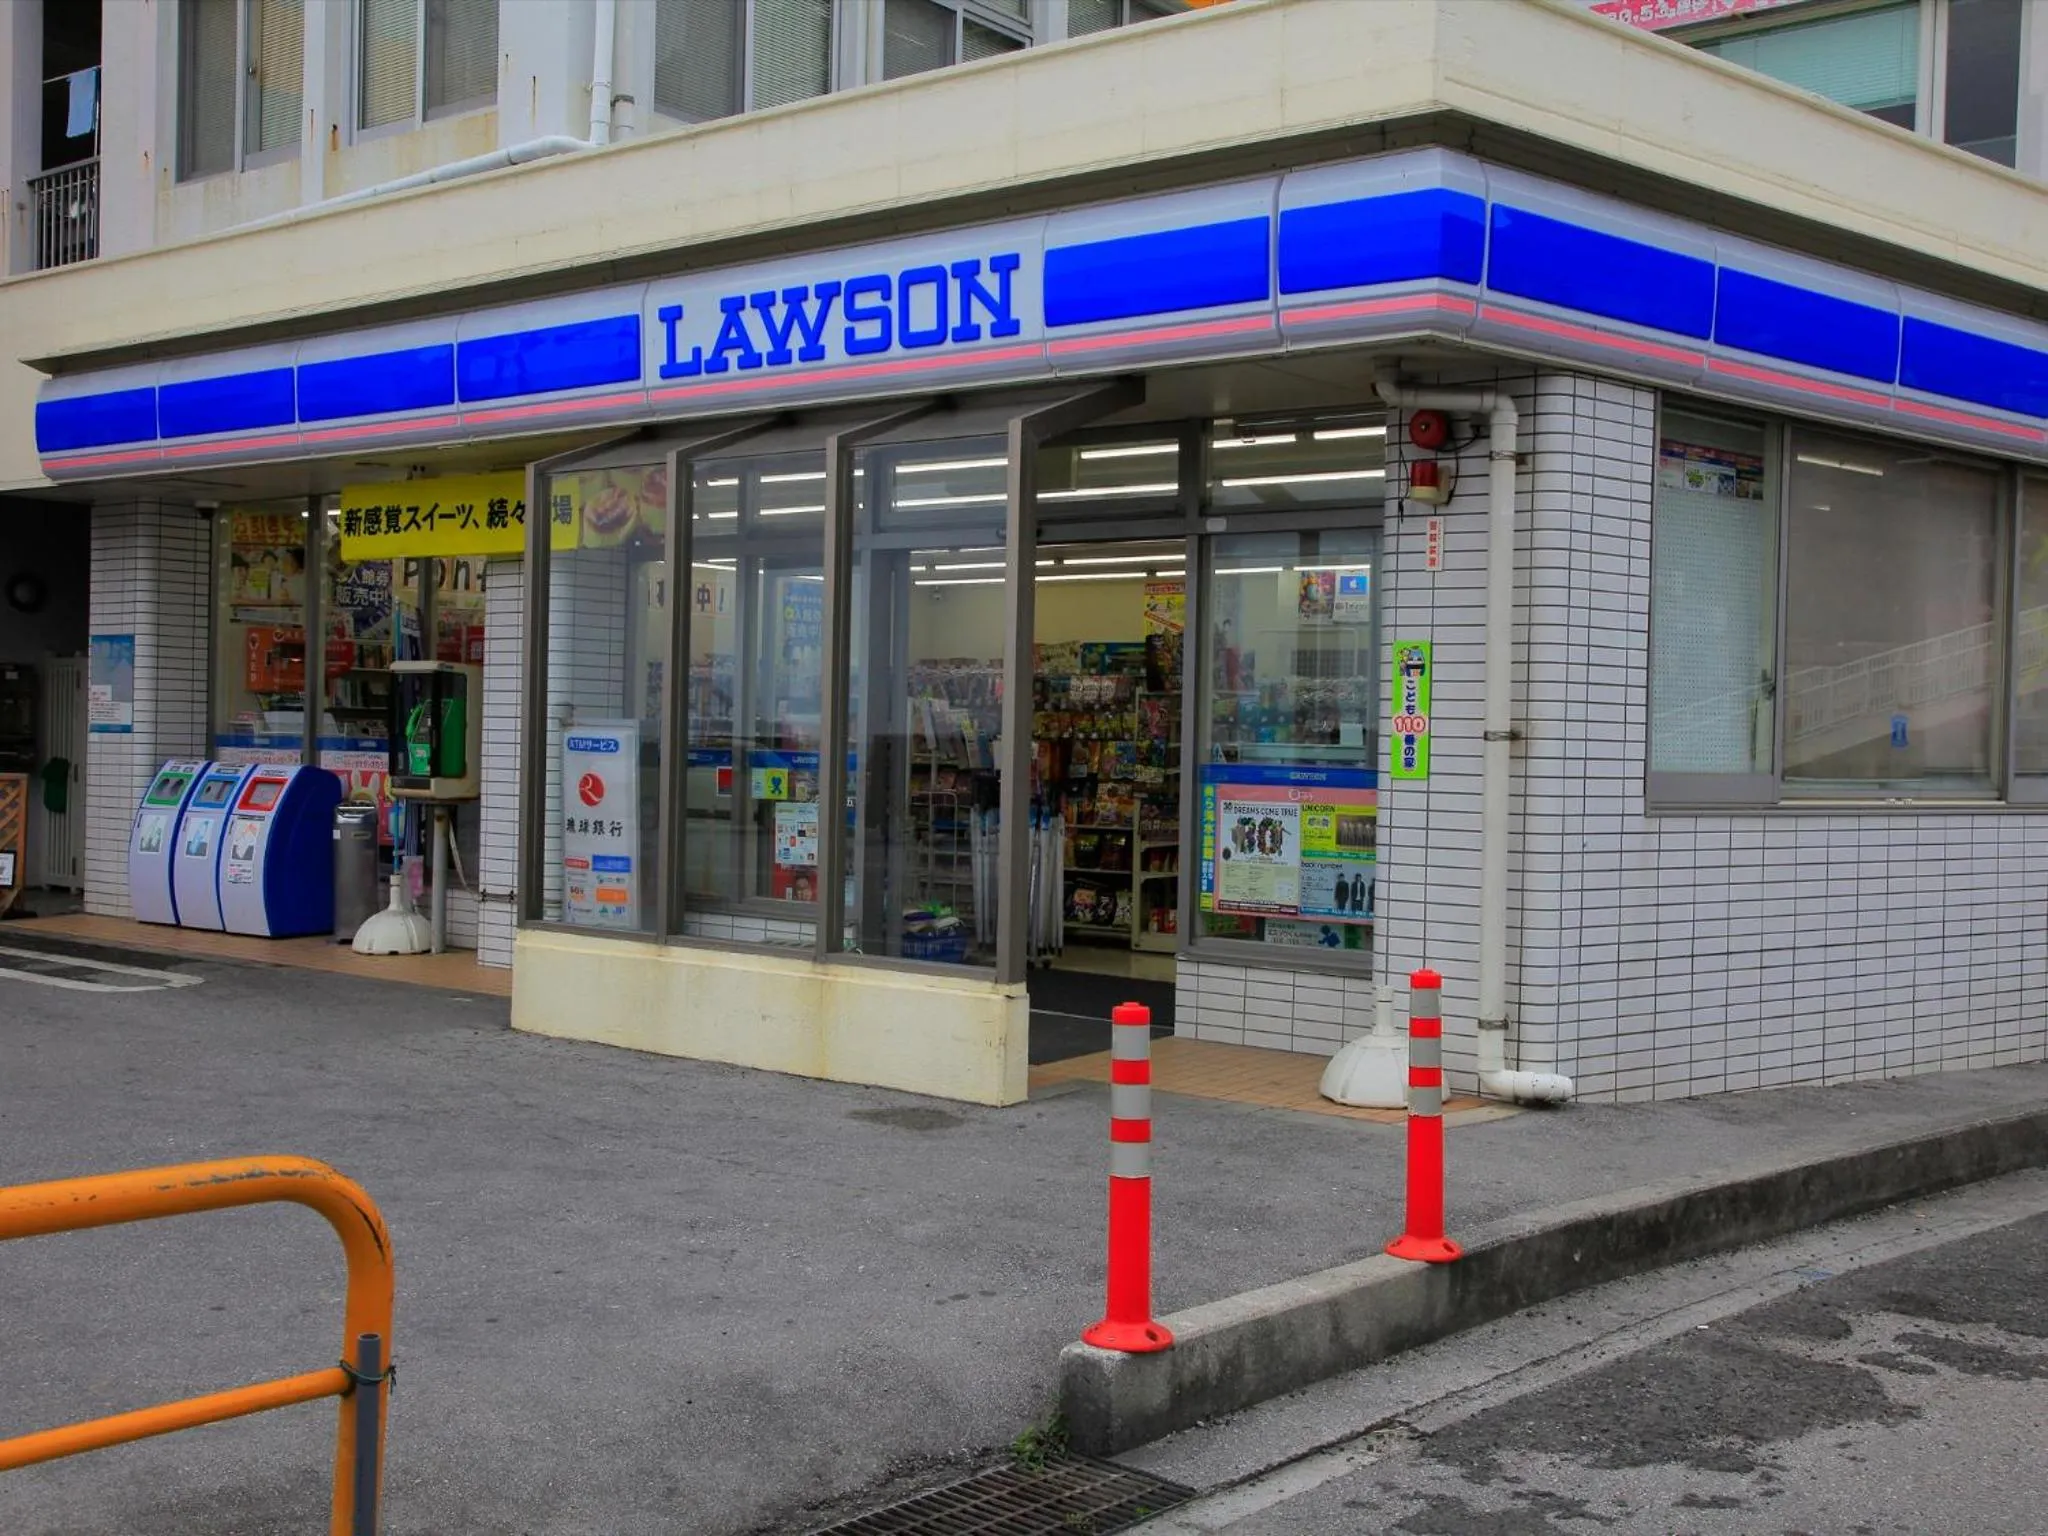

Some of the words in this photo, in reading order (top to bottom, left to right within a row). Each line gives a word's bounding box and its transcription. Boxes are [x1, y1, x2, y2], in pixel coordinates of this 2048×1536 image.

[658, 253, 1020, 379] LAWSON
[344, 494, 573, 539] 新感覚スイーツ、続々場
